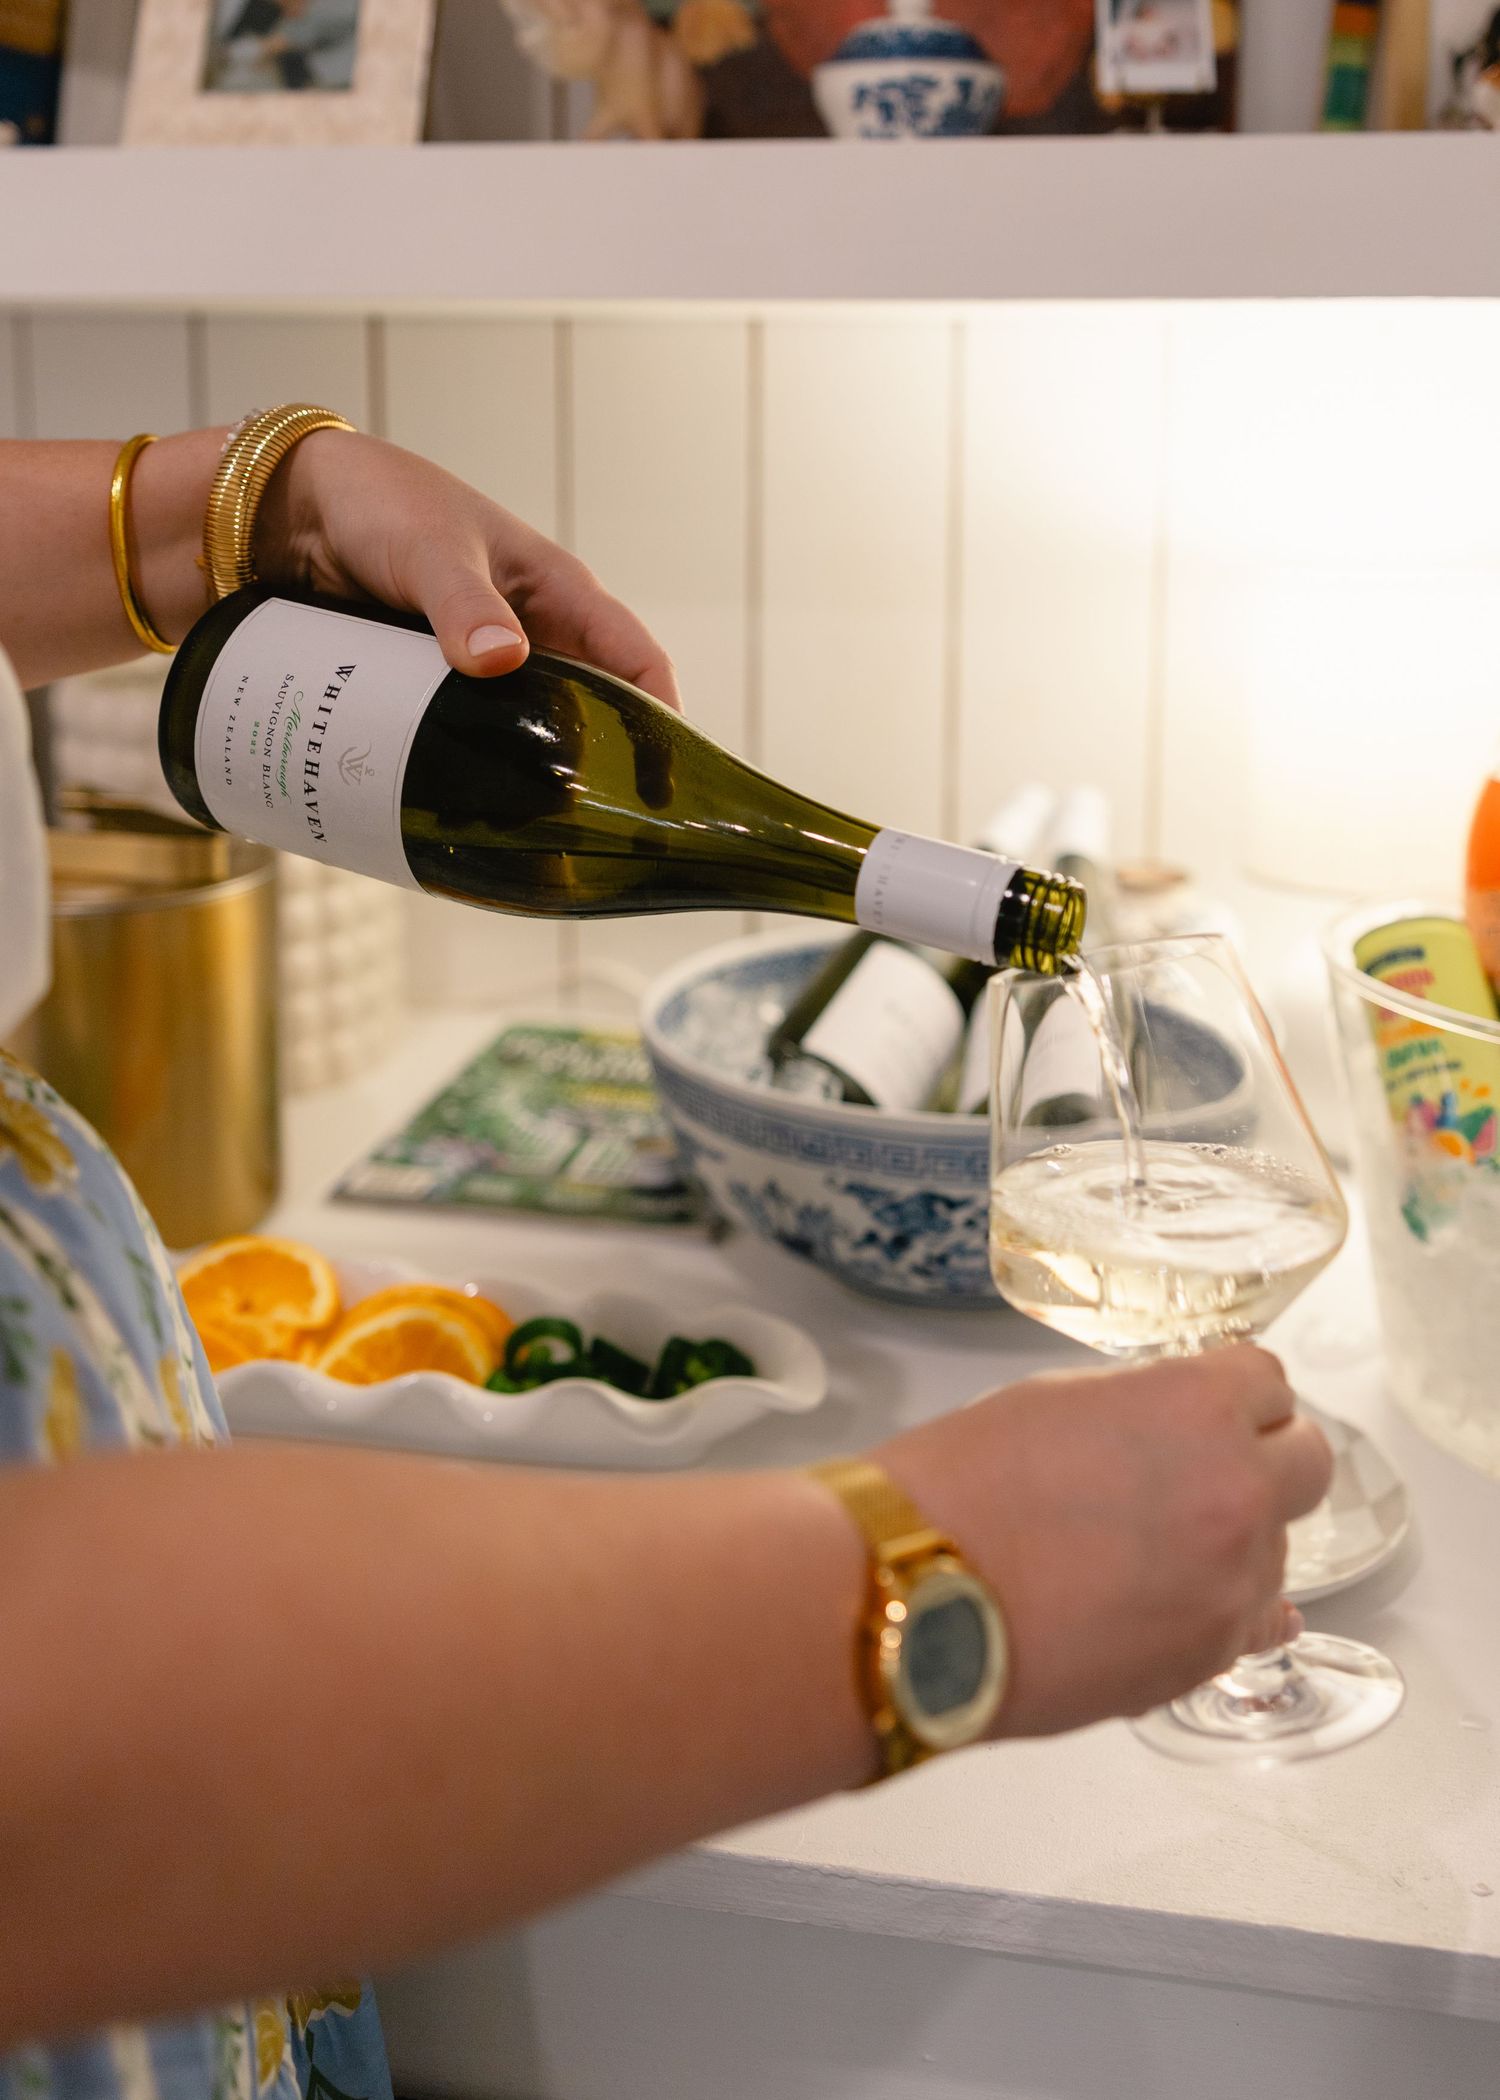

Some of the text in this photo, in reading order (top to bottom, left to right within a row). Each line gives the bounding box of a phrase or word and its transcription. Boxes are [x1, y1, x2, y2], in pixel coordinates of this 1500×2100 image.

[224, 675, 250, 787] NEW ZEALAND
[262, 673, 295, 809] SAUVIGNON BLANC
[275, 690, 304, 804] Marlborough
[303, 663, 358, 844] WHITEHAVEN
